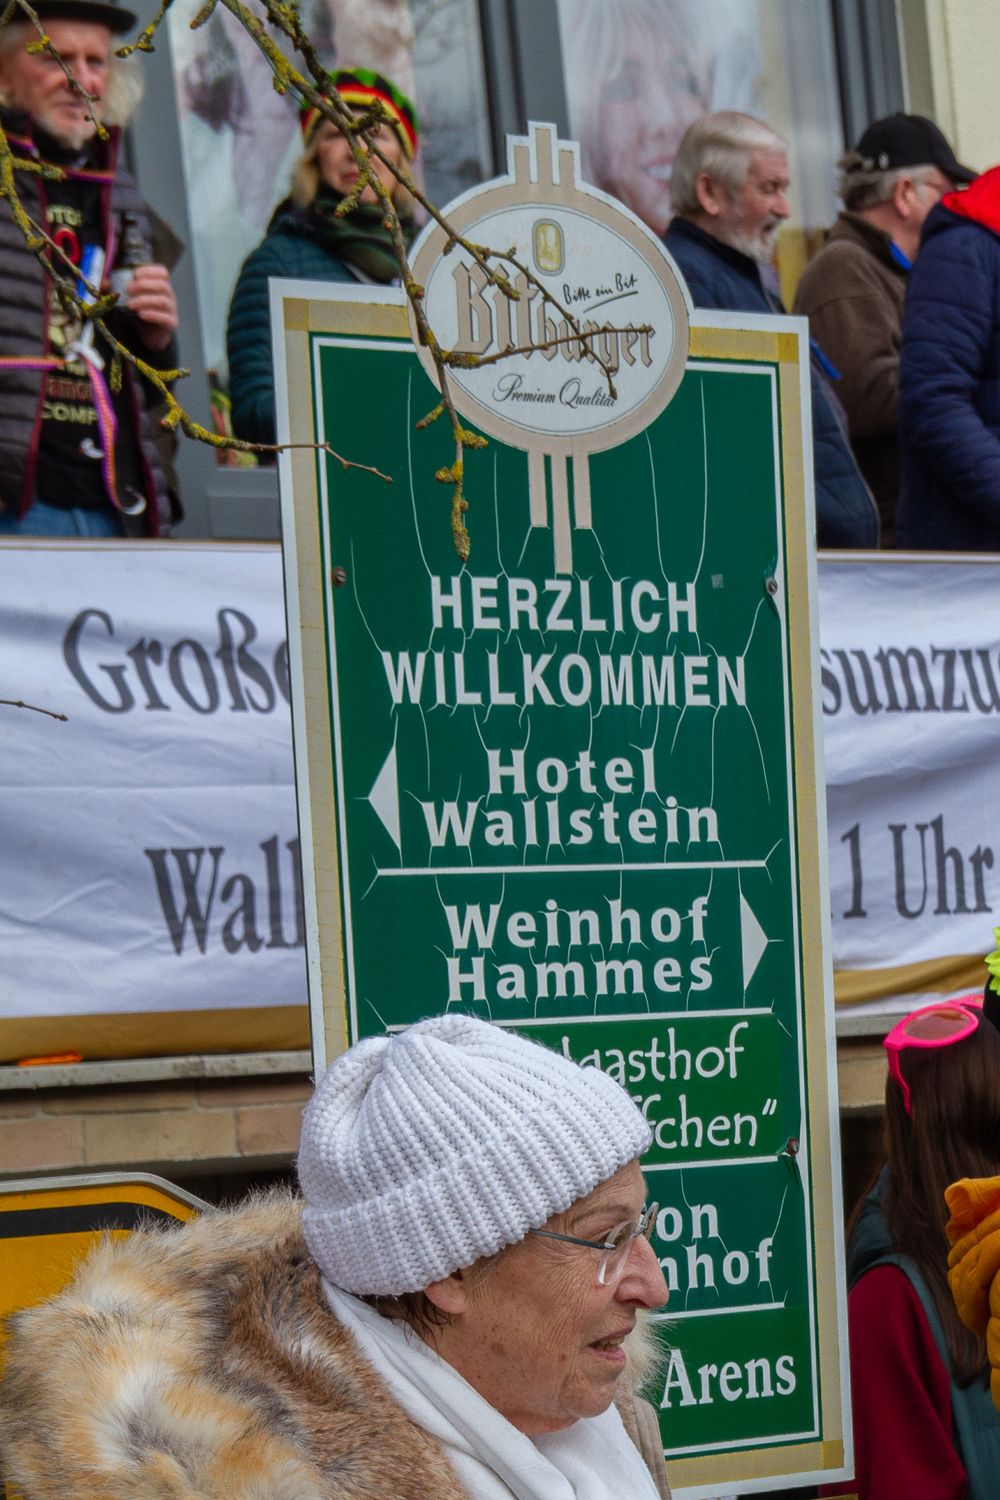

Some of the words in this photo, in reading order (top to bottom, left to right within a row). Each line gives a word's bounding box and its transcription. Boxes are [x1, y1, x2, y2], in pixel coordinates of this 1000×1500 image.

[563, 283, 591, 305] Bitte
[595, 285, 613, 297] ein
[615, 272, 638, 292] Bit
[452, 260, 655, 377] Bitburger
[492, 373, 556, 403] Premium
[431, 576, 698, 634] HERZLICH
[382, 651, 747, 707] WILLKOMMEN
[486, 747, 657, 794] Hotel
[421, 797, 721, 847] Wallstein
[887, 813, 995, 922] Uhr
[444, 897, 708, 949] Weinhof
[447, 956, 713, 1002] Hammes
[660, 1348, 797, 1409] Arens
